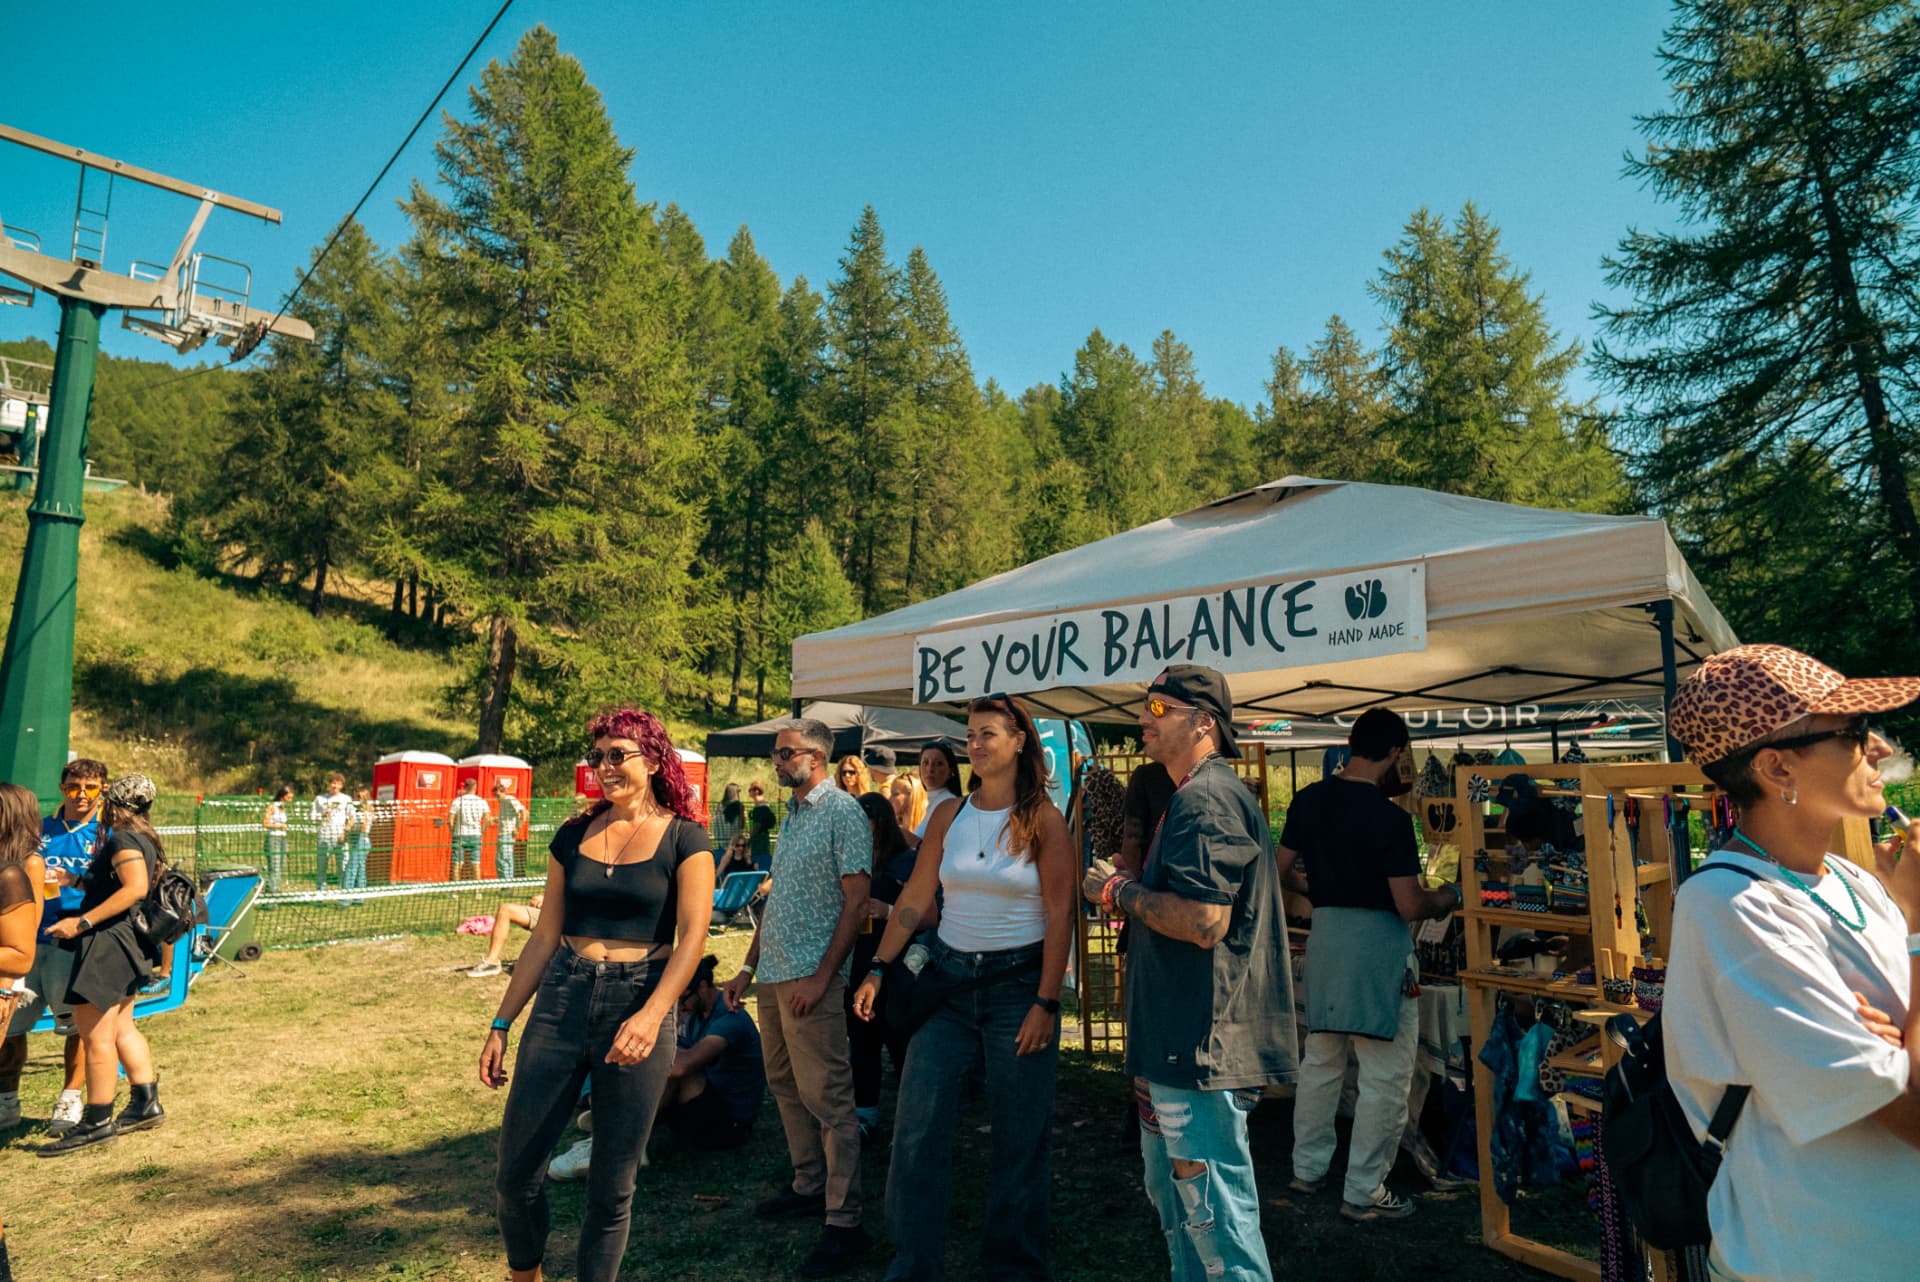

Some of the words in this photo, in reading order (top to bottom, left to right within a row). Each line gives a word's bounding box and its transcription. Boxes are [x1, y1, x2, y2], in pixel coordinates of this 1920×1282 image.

[918, 646, 966, 704] BE
[982, 621, 1089, 693] YOUR
[1101, 580, 1318, 677] BALANCE
[1328, 628, 1363, 646] HAND
[1368, 622, 1405, 641] MADE
[1333, 704, 1540, 729] ULOIR
[45, 855, 91, 869] ONY
